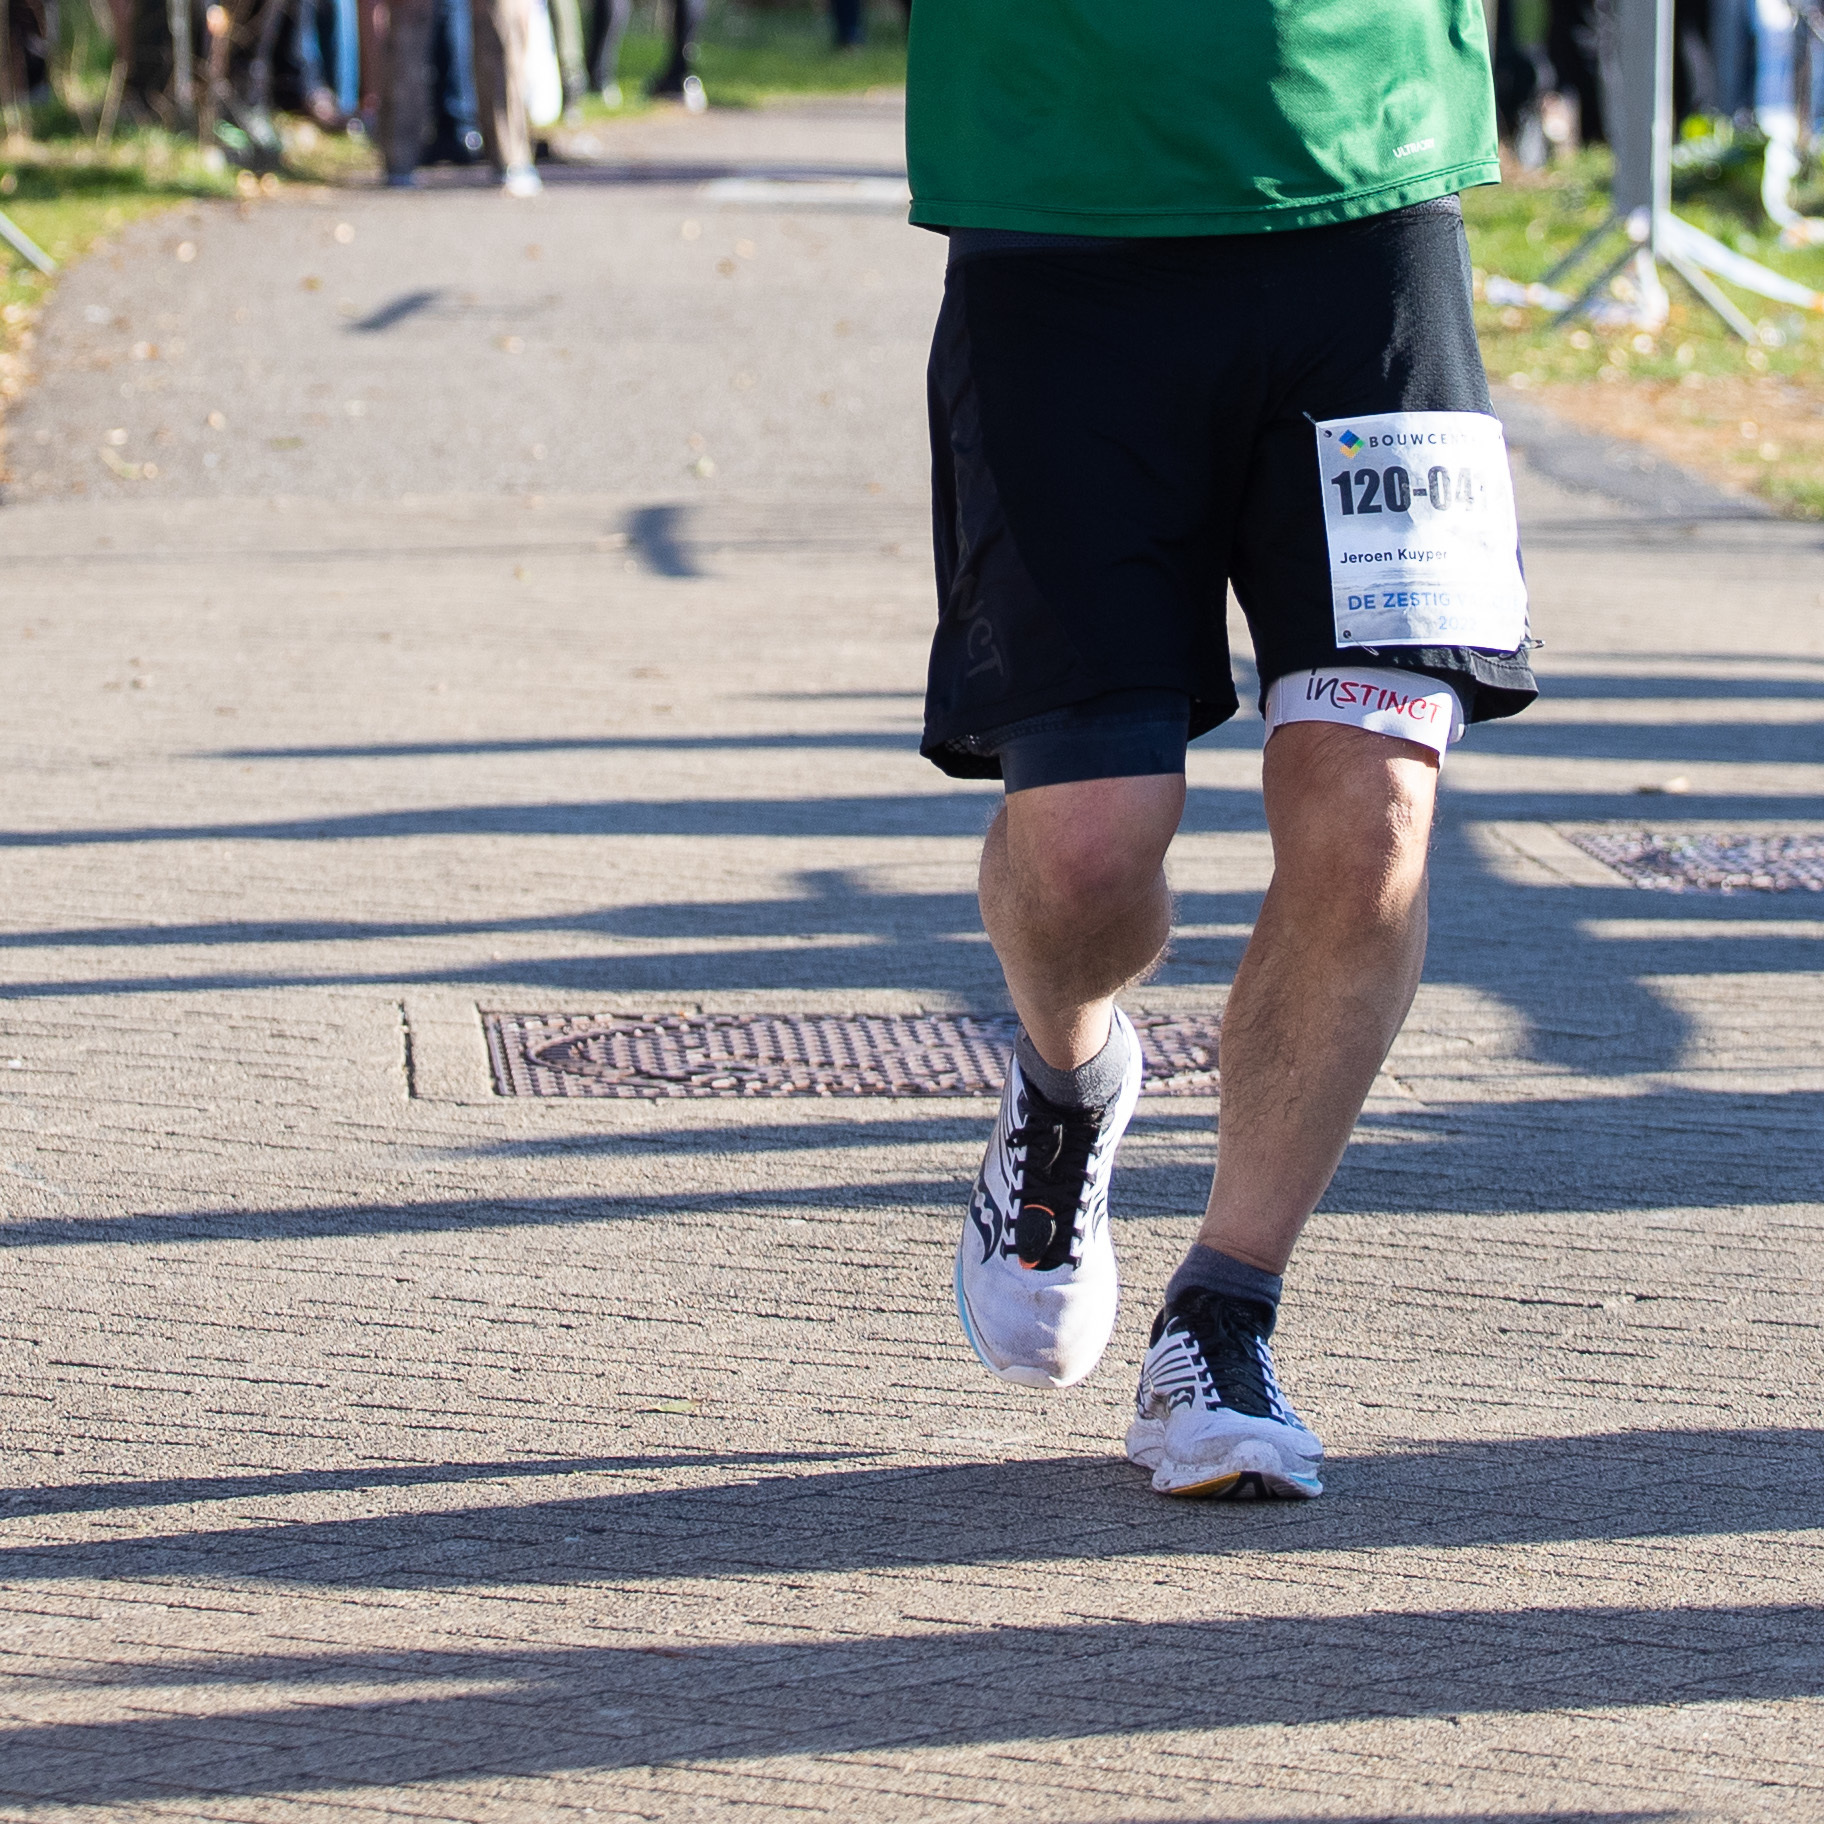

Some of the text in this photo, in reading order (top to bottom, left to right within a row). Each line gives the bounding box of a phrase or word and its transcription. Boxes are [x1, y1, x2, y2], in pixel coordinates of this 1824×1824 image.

[1340, 548, 1447, 564] Jeroen Kuyper
[1348, 594, 1376, 610] DE
[1383, 592, 1450, 608] ZESTIG
